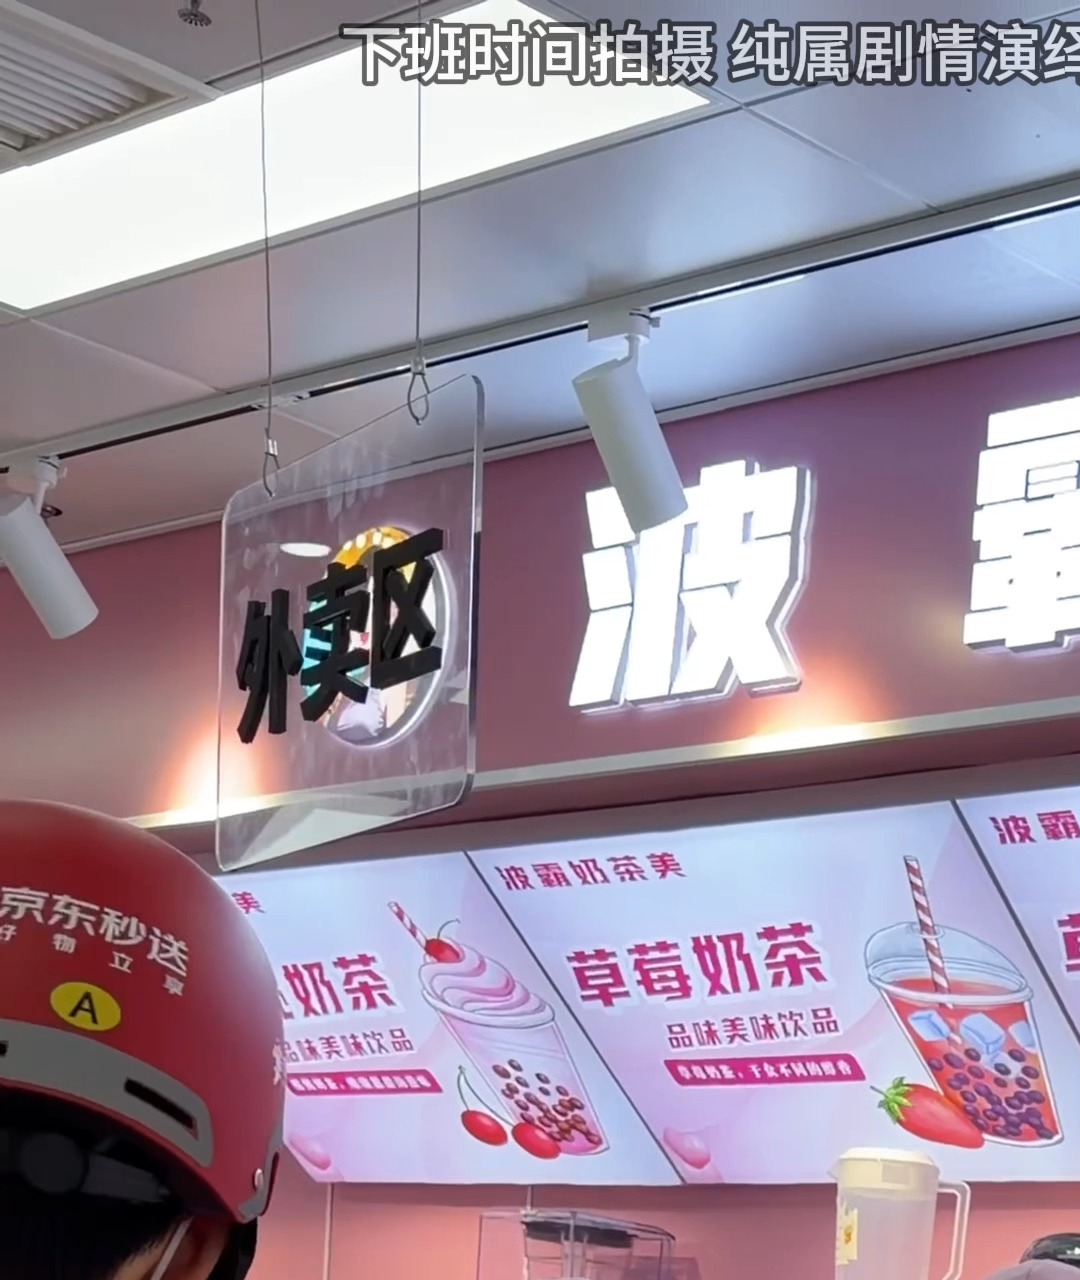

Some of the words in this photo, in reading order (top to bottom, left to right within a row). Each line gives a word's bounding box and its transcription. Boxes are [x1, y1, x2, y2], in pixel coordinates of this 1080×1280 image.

[237, 529, 443, 743] 外卖区
[494, 852, 687, 891] 波霸奶茶美
[0, 887, 189, 977] 京东秒送
[566, 922, 828, 1007] 草莓奶茶
[69, 991, 98, 1025] A
[279, 954, 396, 1019] 奶茶
[666, 1007, 840, 1049] 品味美味饮品
